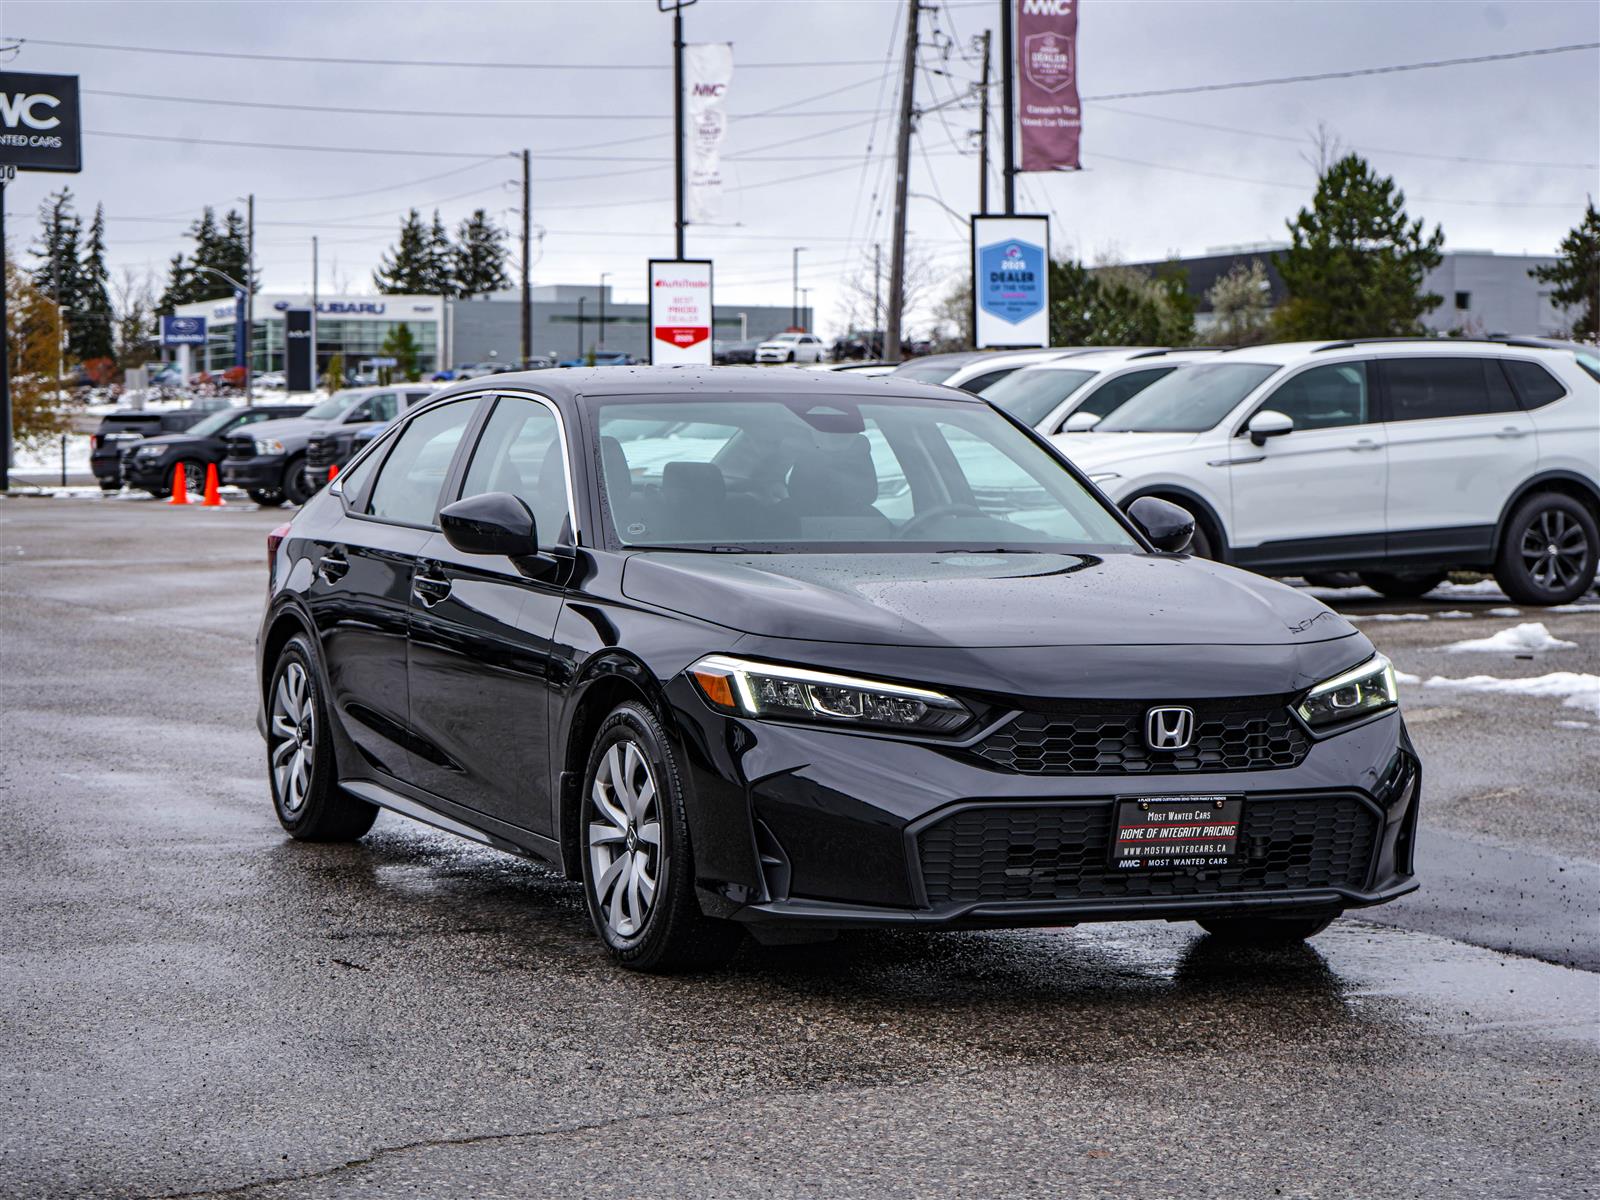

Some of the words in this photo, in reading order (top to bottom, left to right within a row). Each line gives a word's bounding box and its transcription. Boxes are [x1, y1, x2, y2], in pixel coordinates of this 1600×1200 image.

[29, 136, 62, 149] CARS
[990, 272, 1035, 282] DEALER
[1120, 828, 1145, 840] HOME
[1146, 828, 1158, 839] OF
[1159, 826, 1202, 839] INTEGRITY
[1202, 825, 1236, 837] PRICING
[1123, 844, 1227, 856] WWW.MOSTWANTEDCARS.CA
[1147, 859, 1170, 867] MOST
[1173, 858, 1206, 866] WANTED
[1208, 857, 1228, 865] CARS
